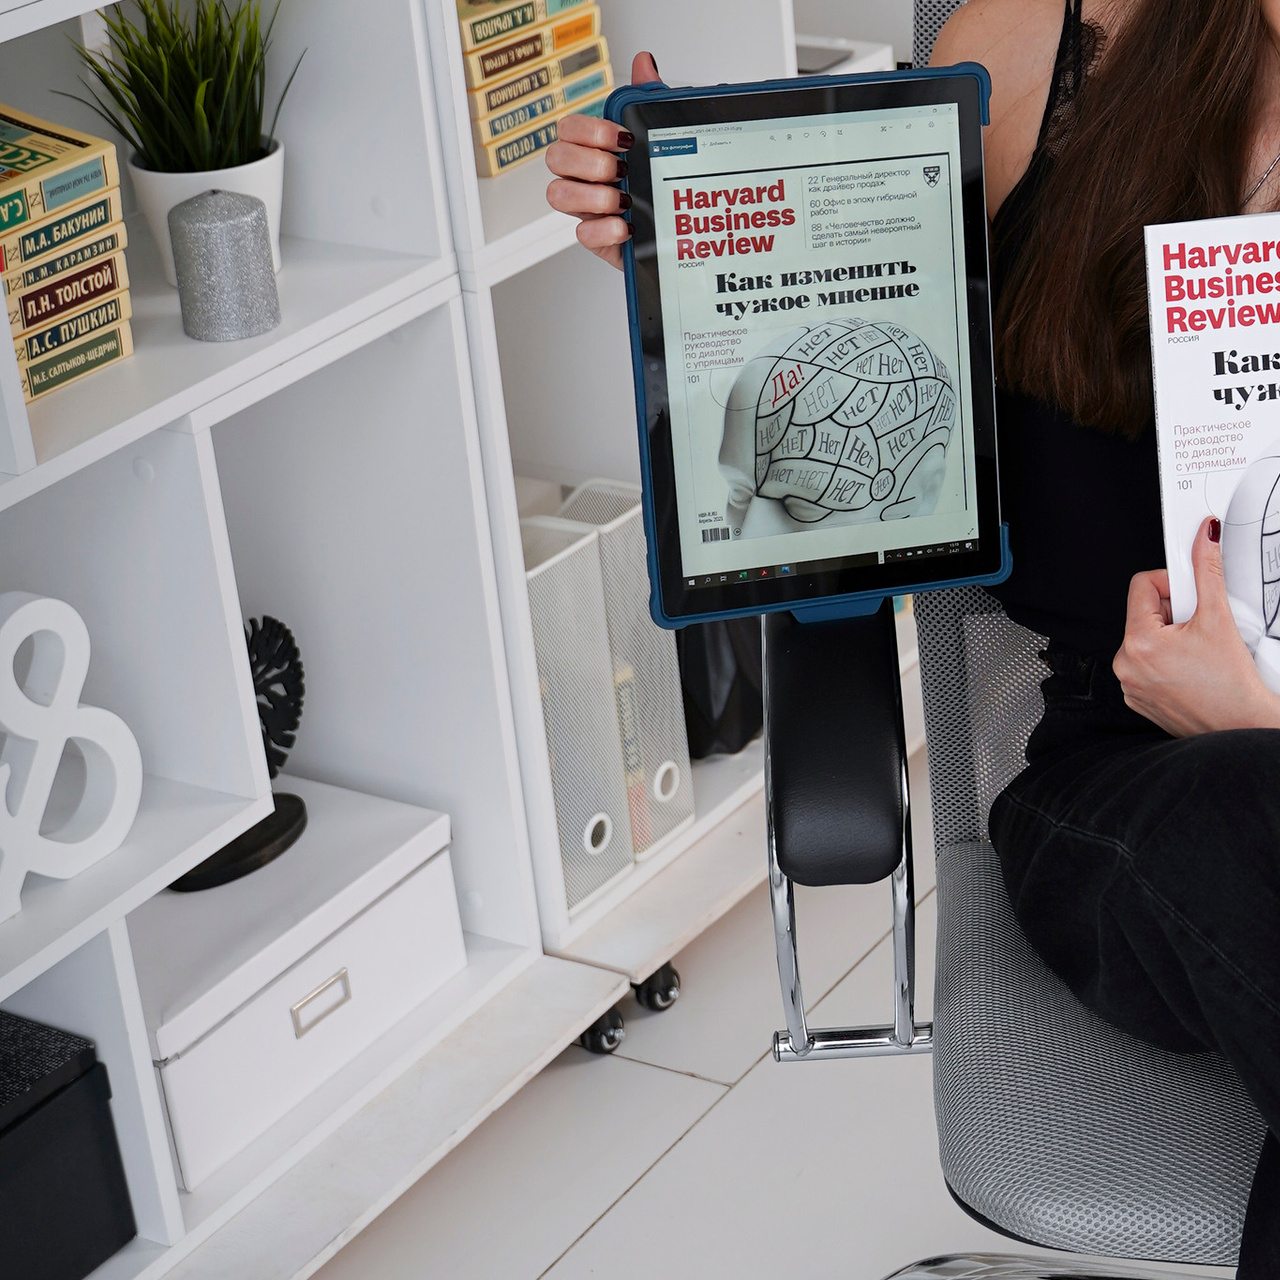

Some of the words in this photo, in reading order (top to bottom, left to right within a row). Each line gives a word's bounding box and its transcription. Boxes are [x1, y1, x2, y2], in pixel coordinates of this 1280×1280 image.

[475, 13, 513, 39] КРЫЛОВ
[490, 78, 531, 106] ШАЛАМОВ
[495, 108, 529, 132] ГОГОЛЬ
[501, 135, 535, 162] ГОГОЛЬ
[808, 176, 818, 184] 22
[821, 172, 873, 183] Генеральный
[874, 169, 910, 179] директор
[673, 179, 785, 210] Harvard
[823, 182, 855, 193] драйвер
[857, 181, 885, 190] продаж
[810, 200, 821, 208] 60
[823, 198, 845, 208] Офис
[876, 191, 917, 201] гибридной
[810, 208, 838, 217] работы
[52, 205, 106, 243] БАКУНИН
[675, 208, 795, 235] Business
[811, 223, 822, 232] 88
[825, 219, 884, 230] «Человечество
[886, 216, 915, 225] должно
[812, 232, 842, 241] сделать
[844, 228, 869, 237] самый
[871, 223, 921, 235] невероятный
[677, 232, 775, 260] Review
[836, 237, 871, 247] истории»
[56, 236, 114, 271] КАРАМЗИН
[715, 272, 774, 293] Как
[780, 261, 917, 288] изменить
[27, 293, 56, 320] Л.Н.
[56, 264, 114, 304] ТОЛСТОЙ
[715, 294, 810, 320] чужое
[817, 283, 920, 307] мнение
[31, 331, 58, 357] А.С.
[60, 301, 118, 340] ПУШКИН
[684, 328, 748, 341] Практическое
[685, 338, 741, 351] руководство
[1168, 335, 1199, 344] РОССИЯ
[49, 339, 118, 379] САЛТЫКОВ-ЩЕДРИН
[699, 348, 735, 360] диалогу
[694, 357, 744, 369] упрямцами
[687, 375, 700, 383] 101
[772, 364, 805, 408] Да!
[1174, 420, 1251, 437] Практическое
[1174, 433, 1243, 449] руководство
[1176, 450, 1189, 459] по
[1192, 445, 1236, 459] диалогу
[1176, 463, 1182, 471] с
[1185, 456, 1247, 472] упрямцами
[1177, 480, 1193, 490] 101
